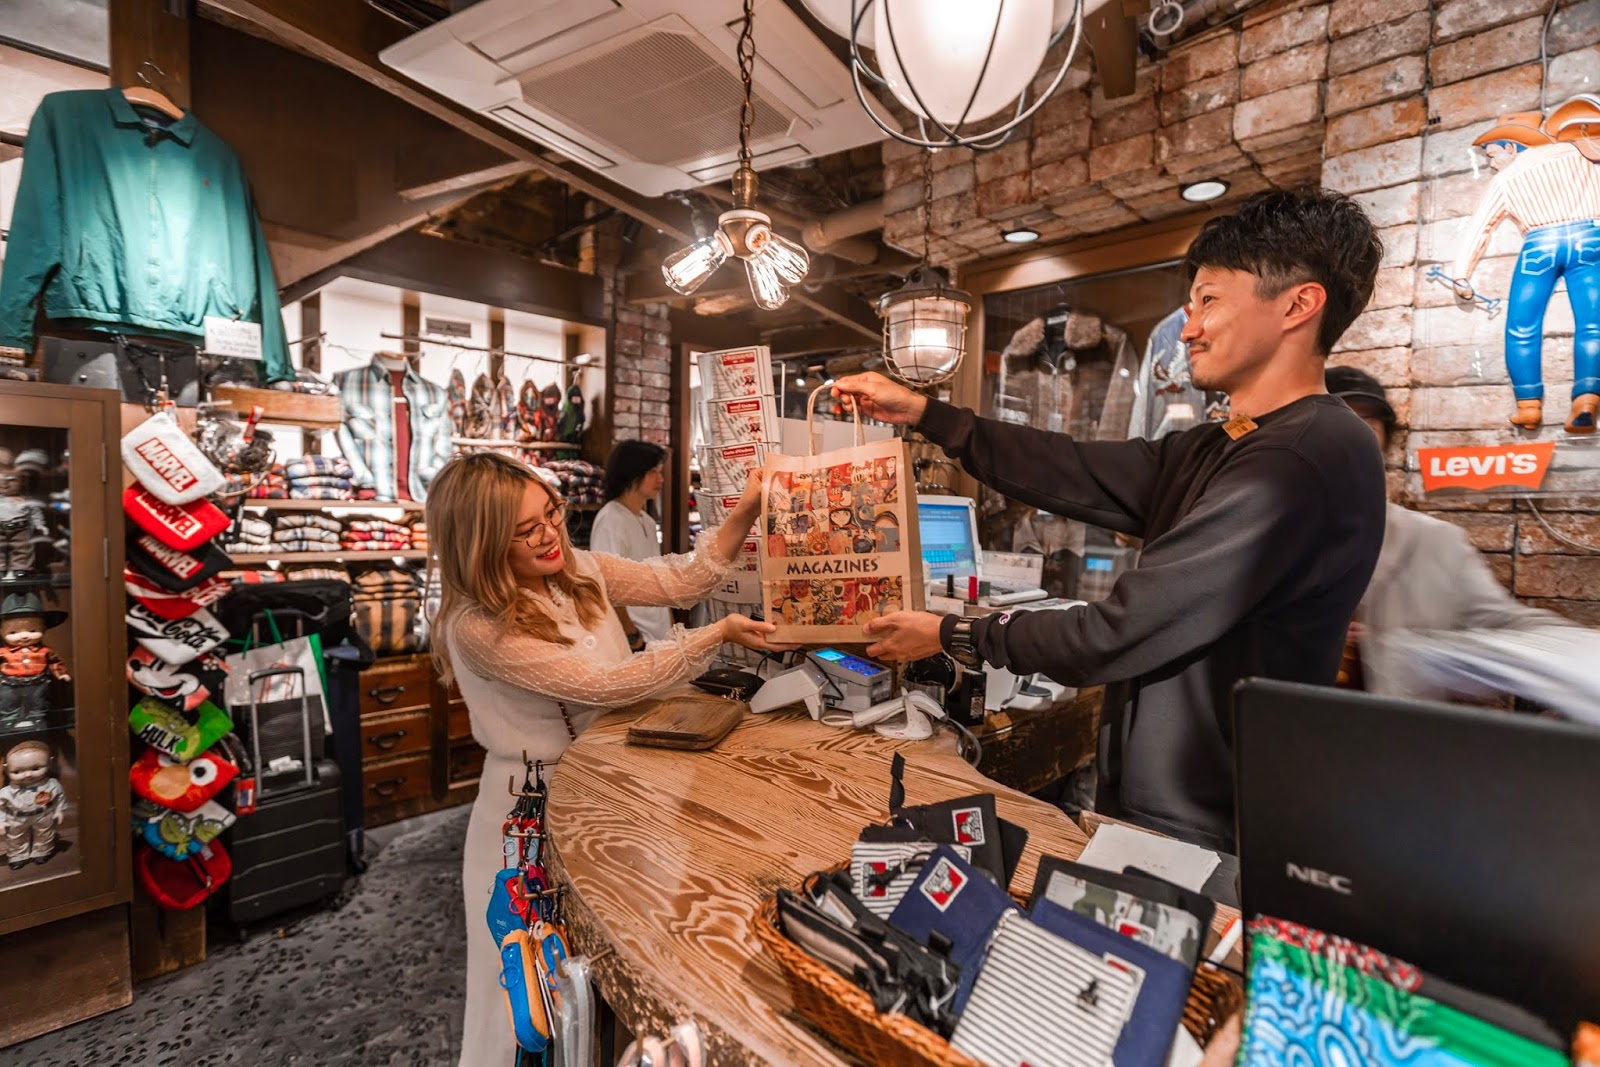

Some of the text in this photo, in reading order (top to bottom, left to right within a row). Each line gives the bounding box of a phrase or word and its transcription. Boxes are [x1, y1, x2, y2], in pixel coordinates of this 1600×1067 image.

[136, 438, 197, 492] MARVEL
[787, 559, 878, 575] MAGAZINES
[139, 723, 181, 753] HULK
[1286, 862, 1353, 895] NEC
